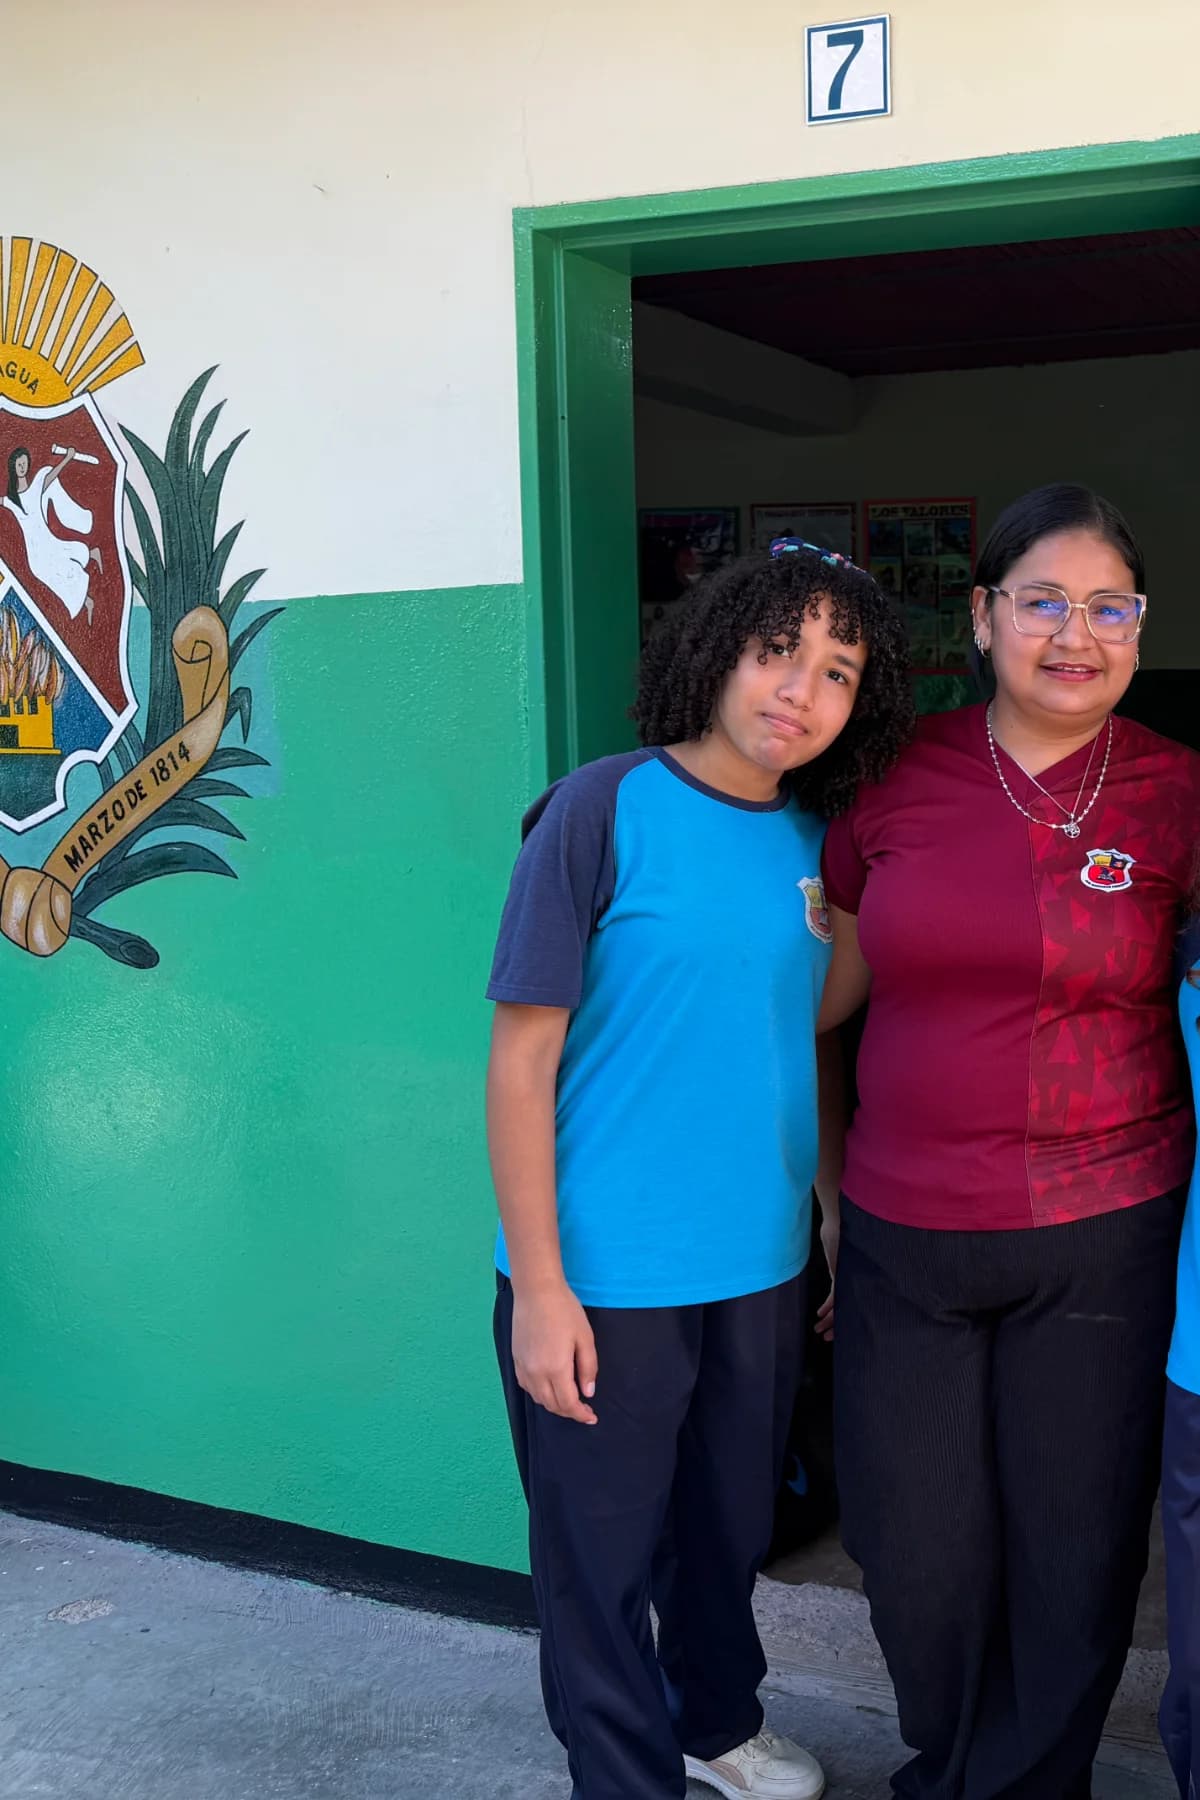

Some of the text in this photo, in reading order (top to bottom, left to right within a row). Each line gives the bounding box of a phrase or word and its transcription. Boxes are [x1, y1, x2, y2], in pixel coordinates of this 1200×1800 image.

[826, 29, 864, 110] 7
[901, 503, 968, 517] VALORES
[63, 741, 190, 873] MARZO DE 1814
